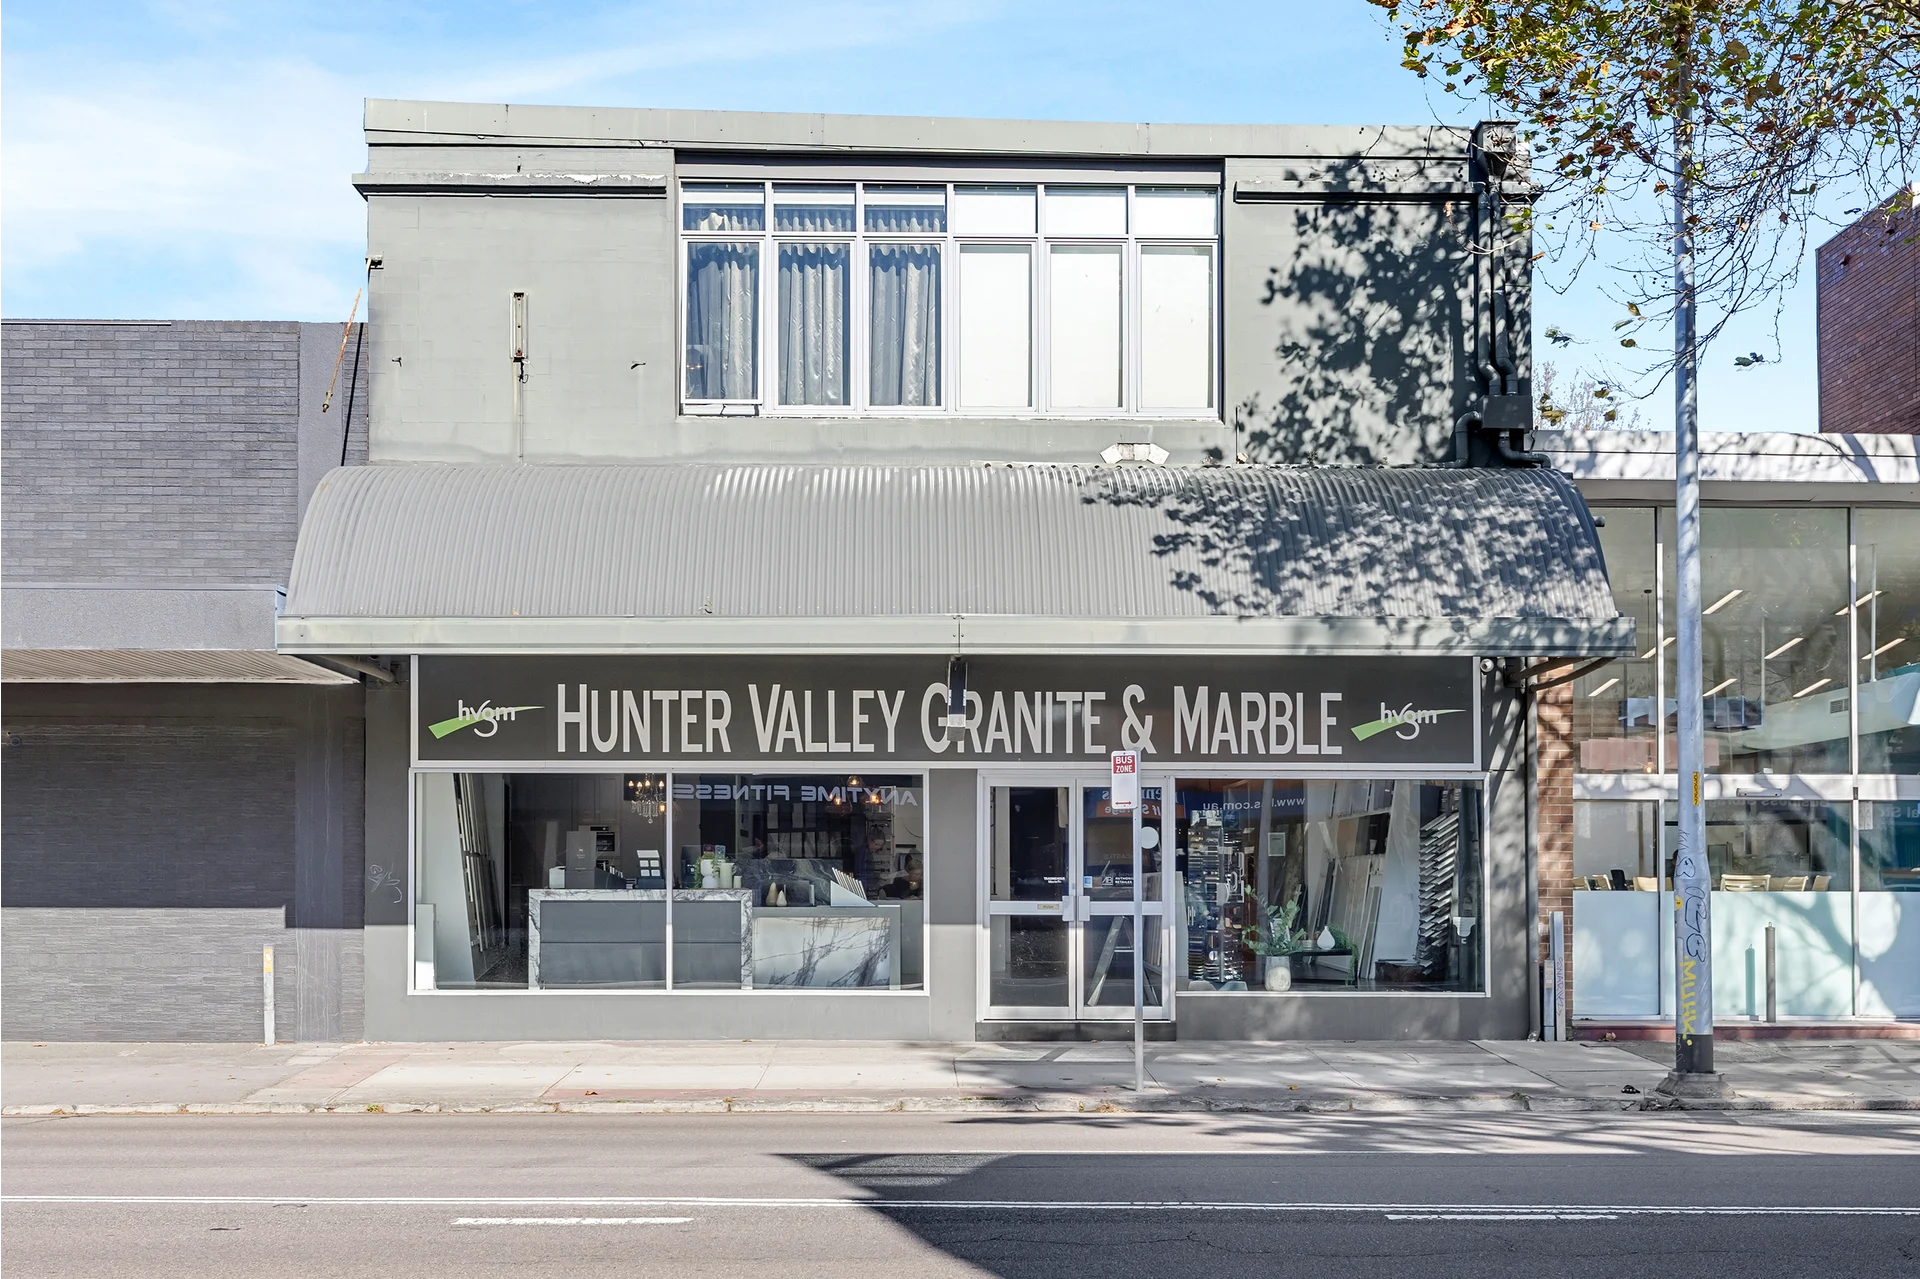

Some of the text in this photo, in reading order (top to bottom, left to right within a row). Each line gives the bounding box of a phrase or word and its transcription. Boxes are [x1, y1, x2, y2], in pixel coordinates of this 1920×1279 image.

[557, 683, 732, 753] HUNTER
[748, 683, 906, 753] VALLEY
[1121, 684, 1157, 754] &
[1173, 685, 1343, 755] MARBLE
[1115, 756, 1133, 764] BUS
[1115, 765, 1133, 773] ZONE
